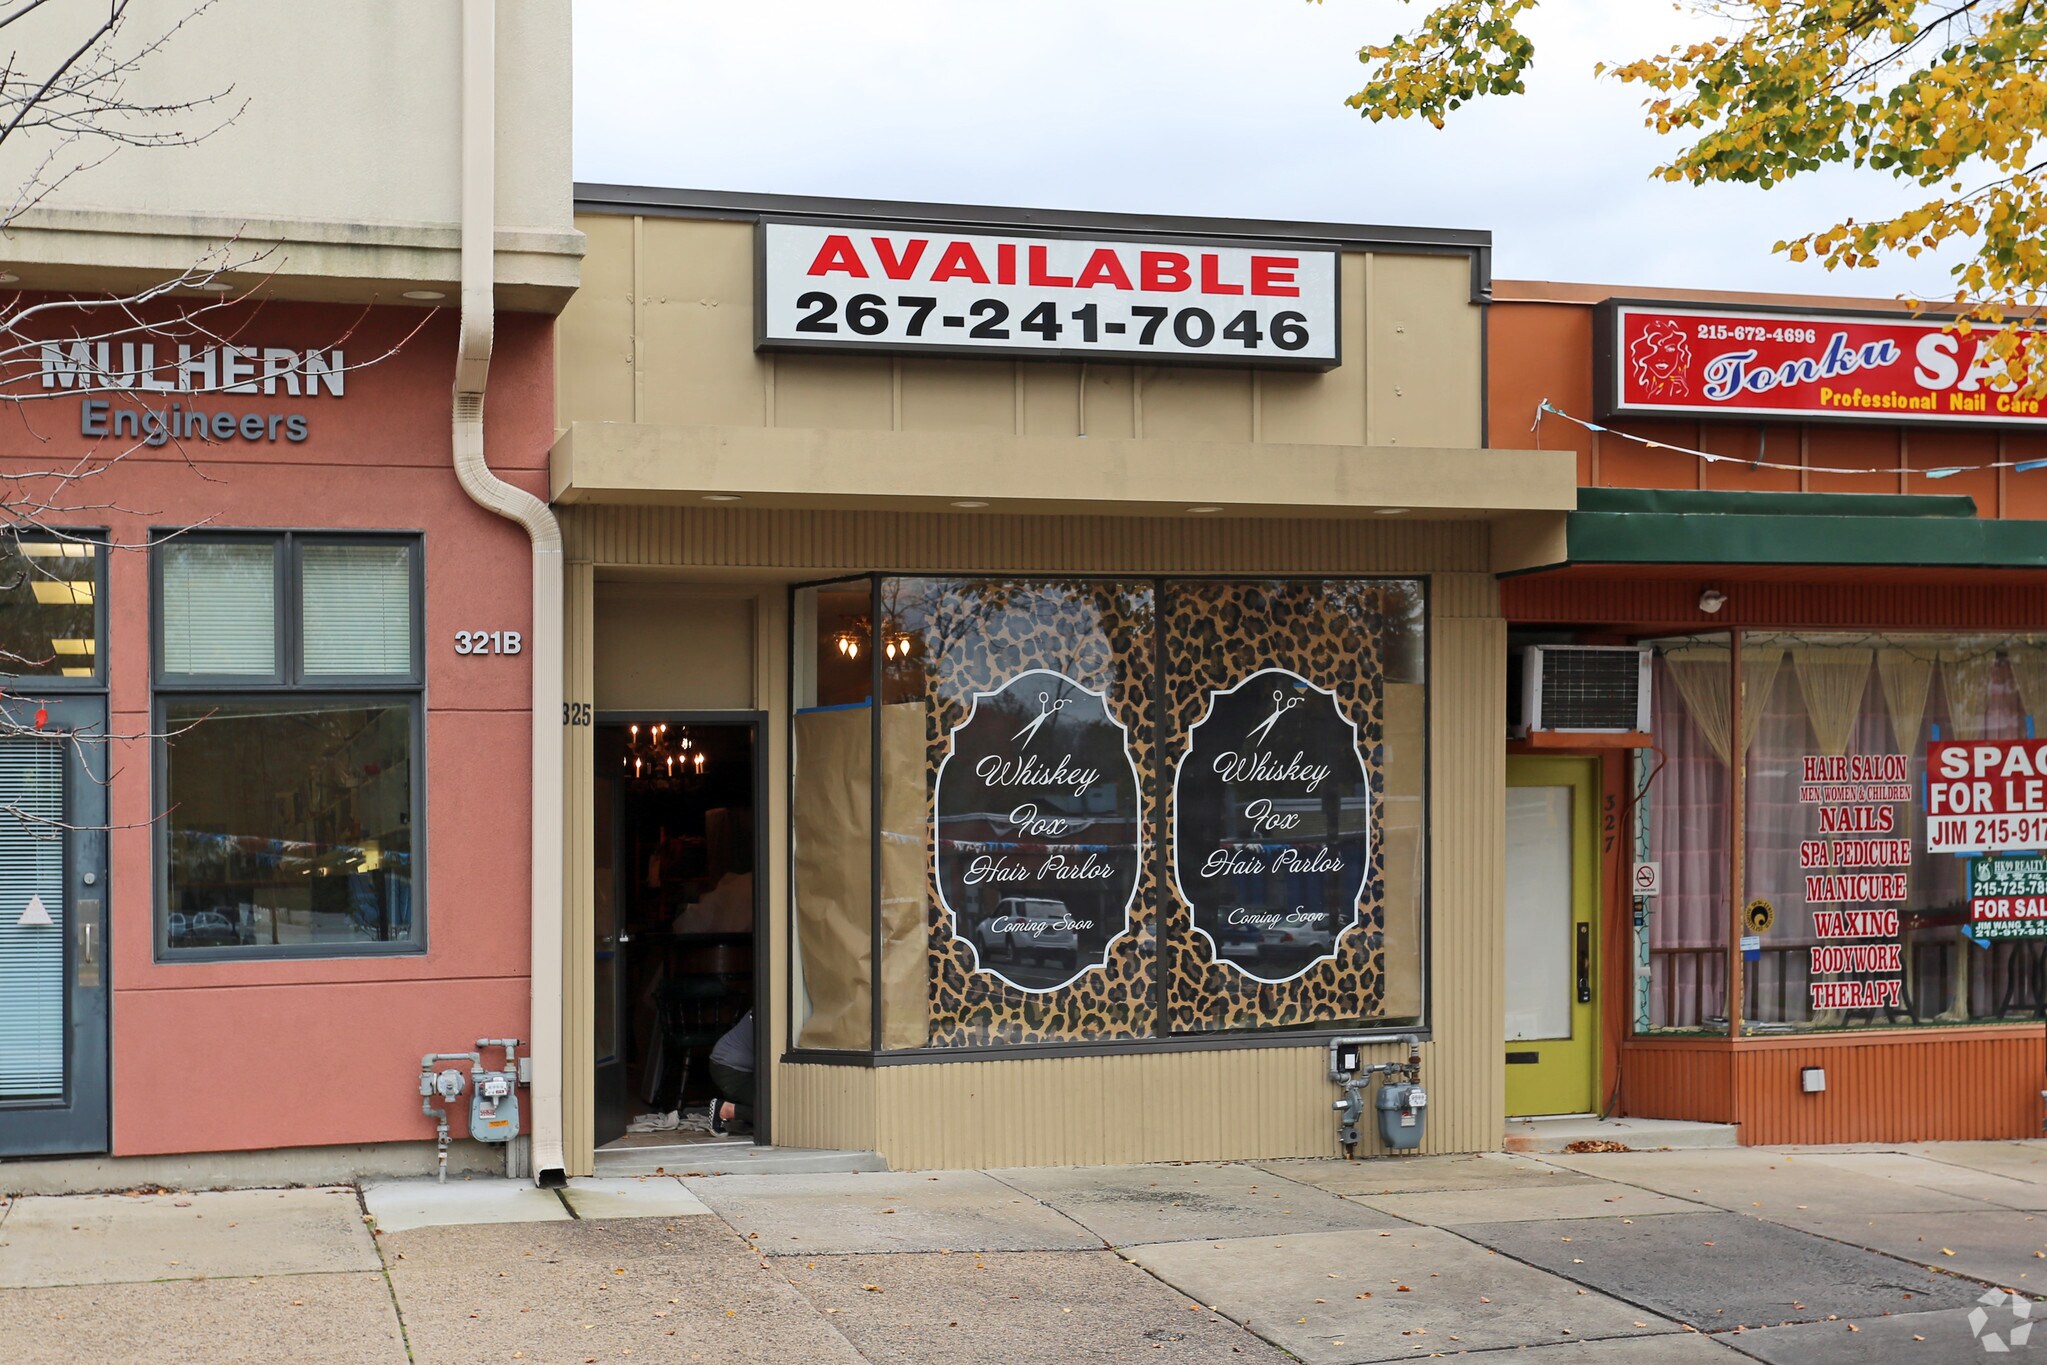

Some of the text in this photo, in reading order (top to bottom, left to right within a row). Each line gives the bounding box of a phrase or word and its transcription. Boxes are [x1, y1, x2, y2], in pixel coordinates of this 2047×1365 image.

[806, 234, 1300, 298] AVAILABLE
[795, 291, 1310, 351] 267-241-7046
[1697, 324, 1816, 344] 215-672-4696
[41, 341, 344, 397] MULHERN
[1703, 332, 1901, 401] Tonku
[1820, 387, 2039, 414] Professional Nail Care
[81, 399, 309, 446] Engineers
[454, 630, 522, 655] 321B
[975, 754, 1100, 798] Whiskey
[1212, 750, 1331, 793] Whiskey
[1803, 755, 1907, 782] HAIR SALON
[1800, 784, 1911, 804] MEN, WOMEN & CHILDREN
[1930, 780, 2047, 815] FOR LE
[1009, 803, 1068, 838] Fox
[1244, 798, 1300, 832] Fox
[1604, 793, 1617, 853] 327
[1818, 805, 1894, 833] NAILS
[1932, 820, 1967, 846] JIM
[1201, 847, 1344, 878] Hair Parlor
[1801, 839, 1911, 868] SPA PEDICURE
[2015, 859, 2043, 872] REALTY
[963, 853, 1115, 885] Hair Parlor
[1806, 874, 1906, 902] MANICURE
[1228, 905, 1325, 930] Coming Soon
[1814, 909, 1899, 938] WAXING
[1974, 899, 2010, 919] FOR
[991, 913, 1094, 938] Coming Soon
[1975, 921, 1992, 930] JIM
[1993, 920, 2022, 930] WANG
[1811, 945, 1901, 973] BODYWORK
[1811, 980, 1901, 1009] THERAPY
